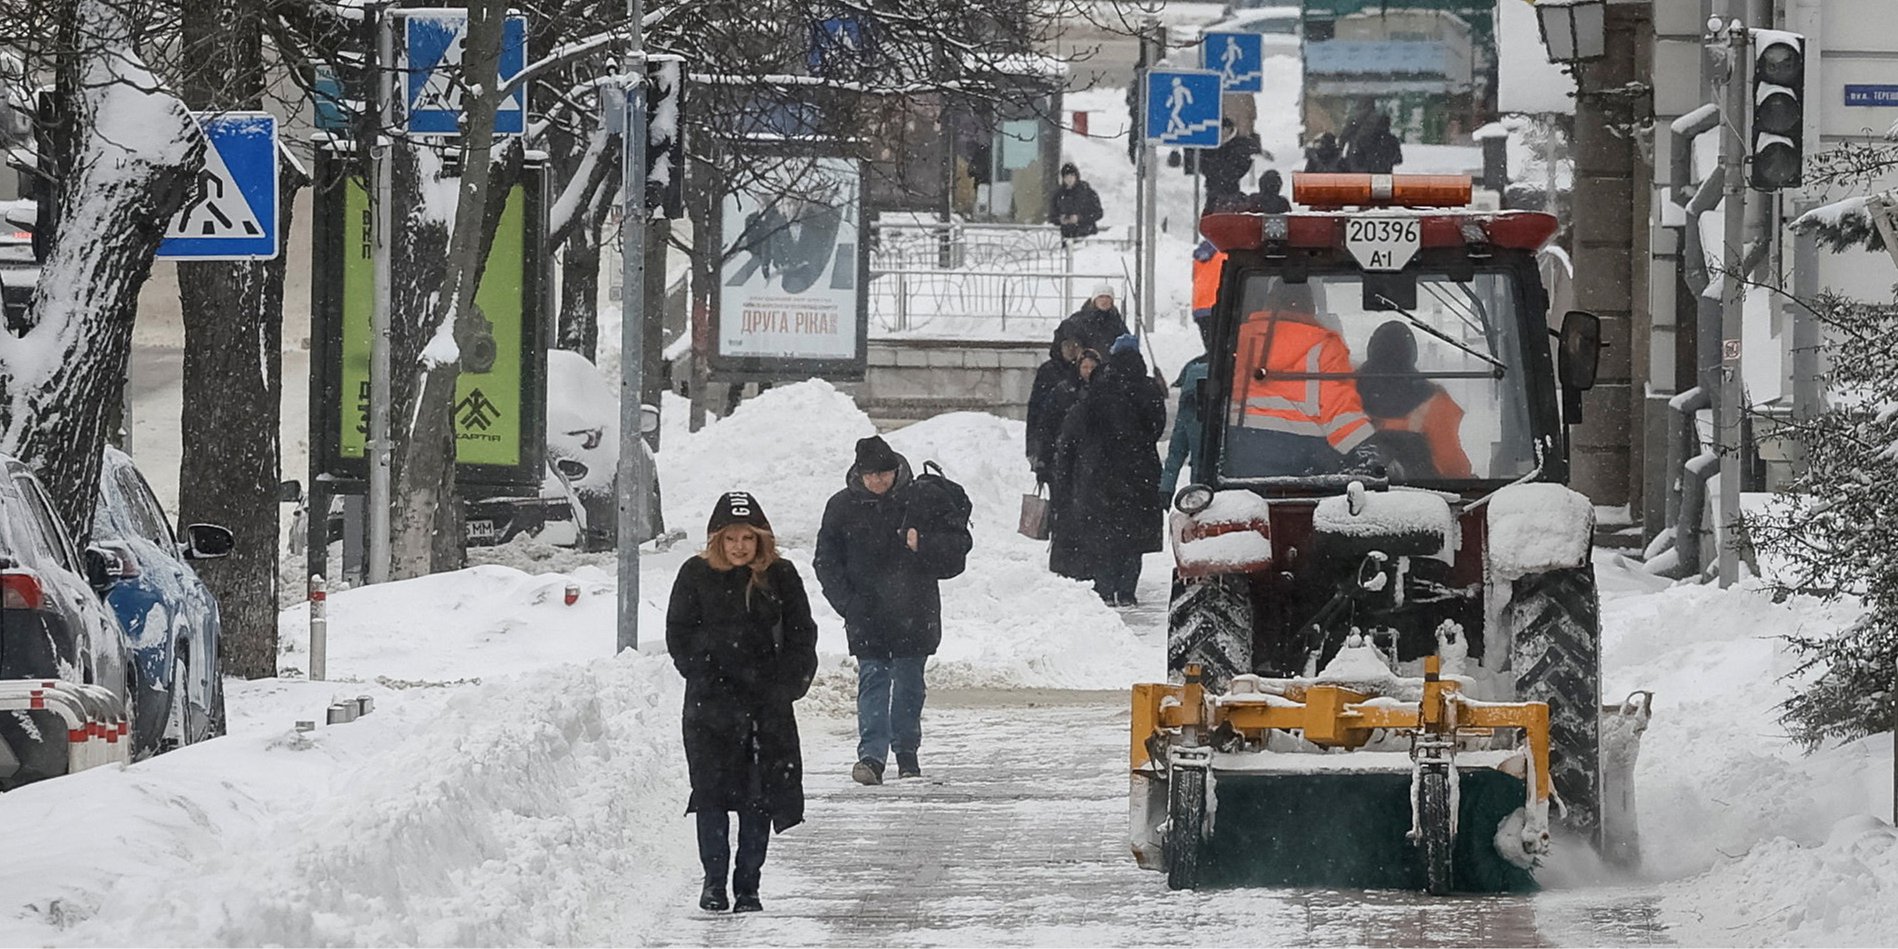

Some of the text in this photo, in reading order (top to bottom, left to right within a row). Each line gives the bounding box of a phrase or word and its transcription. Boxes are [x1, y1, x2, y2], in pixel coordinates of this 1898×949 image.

[1350, 220, 1417, 243] 20396
[741, 310, 789, 335] ДРУГА
[795, 311, 829, 335] РІКА
